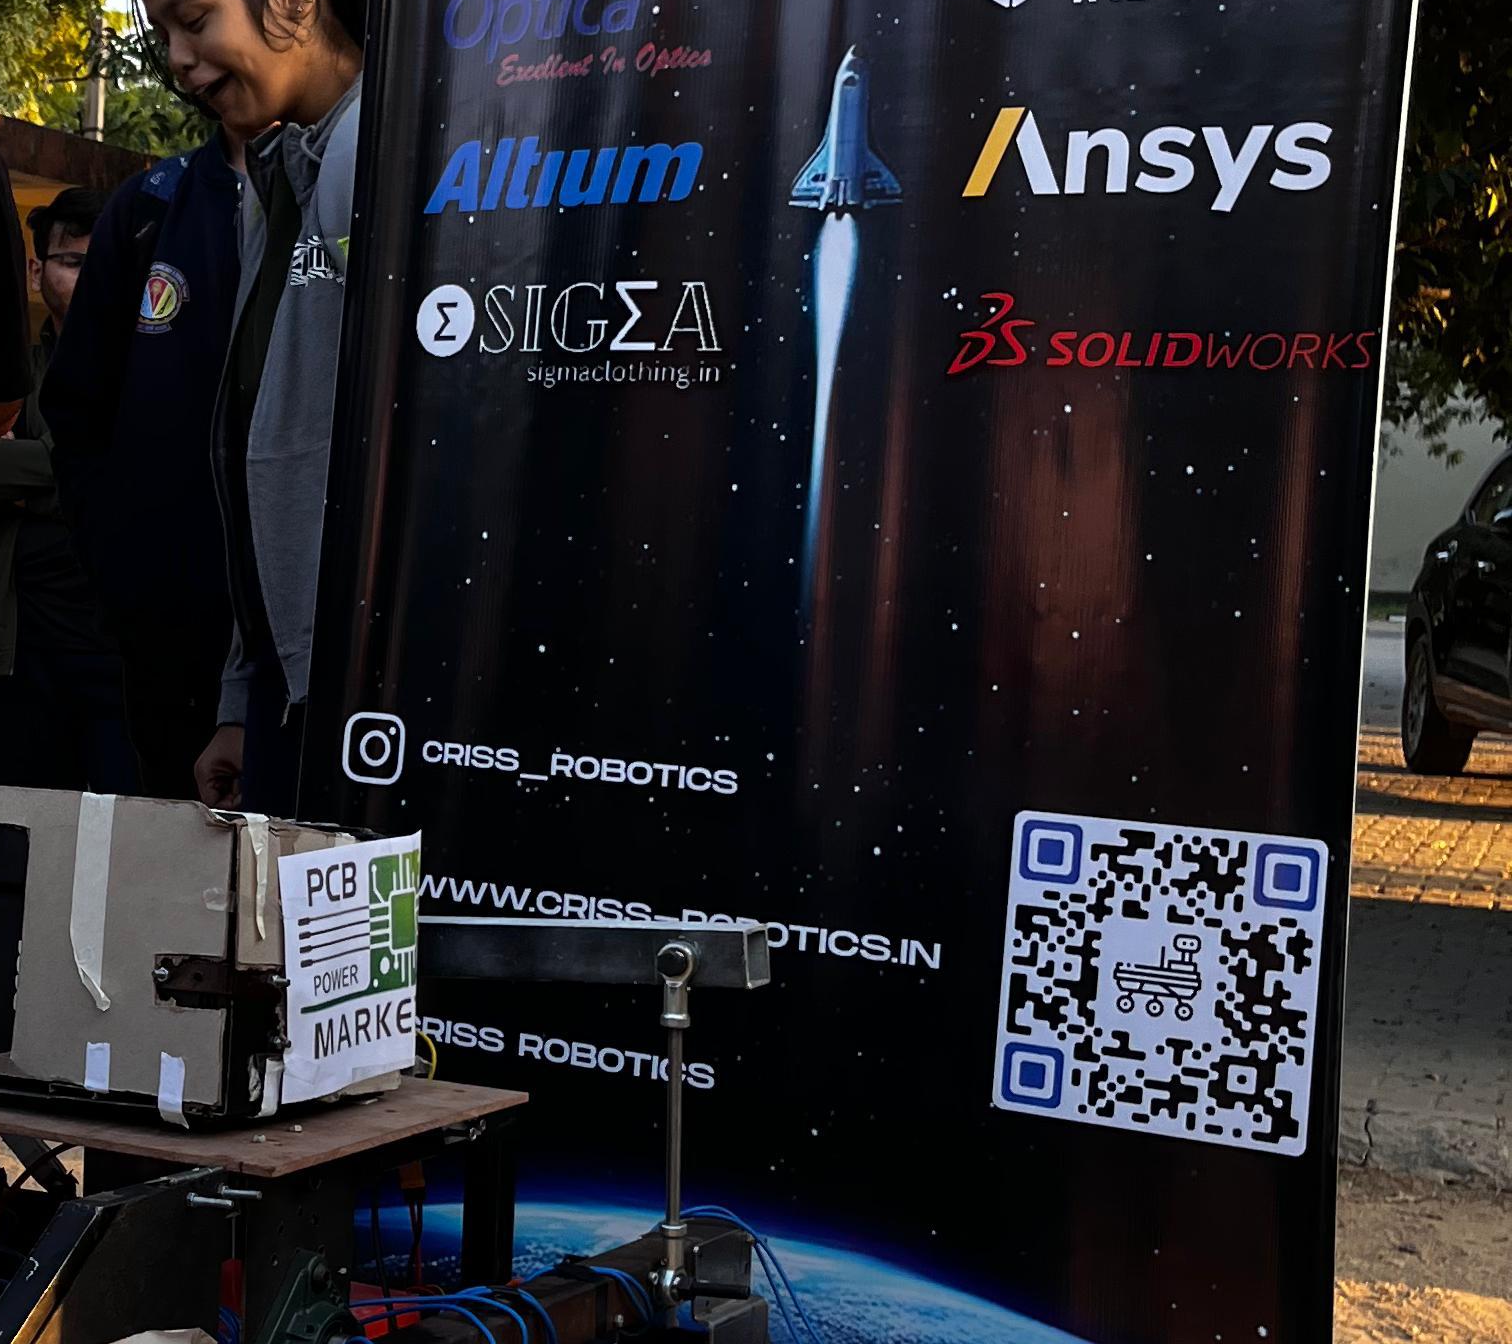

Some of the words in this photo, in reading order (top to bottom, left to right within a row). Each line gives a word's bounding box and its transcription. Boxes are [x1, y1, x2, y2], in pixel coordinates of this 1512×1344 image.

[423, 135, 704, 215] Altium
[961, 106, 1334, 214] Ansys
[526, 359, 721, 390] sigmaclothing.in
[1046, 330, 1376, 371] SOLIDWORKS
[421, 740, 739, 795] CRISS_ROBOTICS
[305, 860, 358, 908] PCB
[313, 964, 360, 997] POWER
